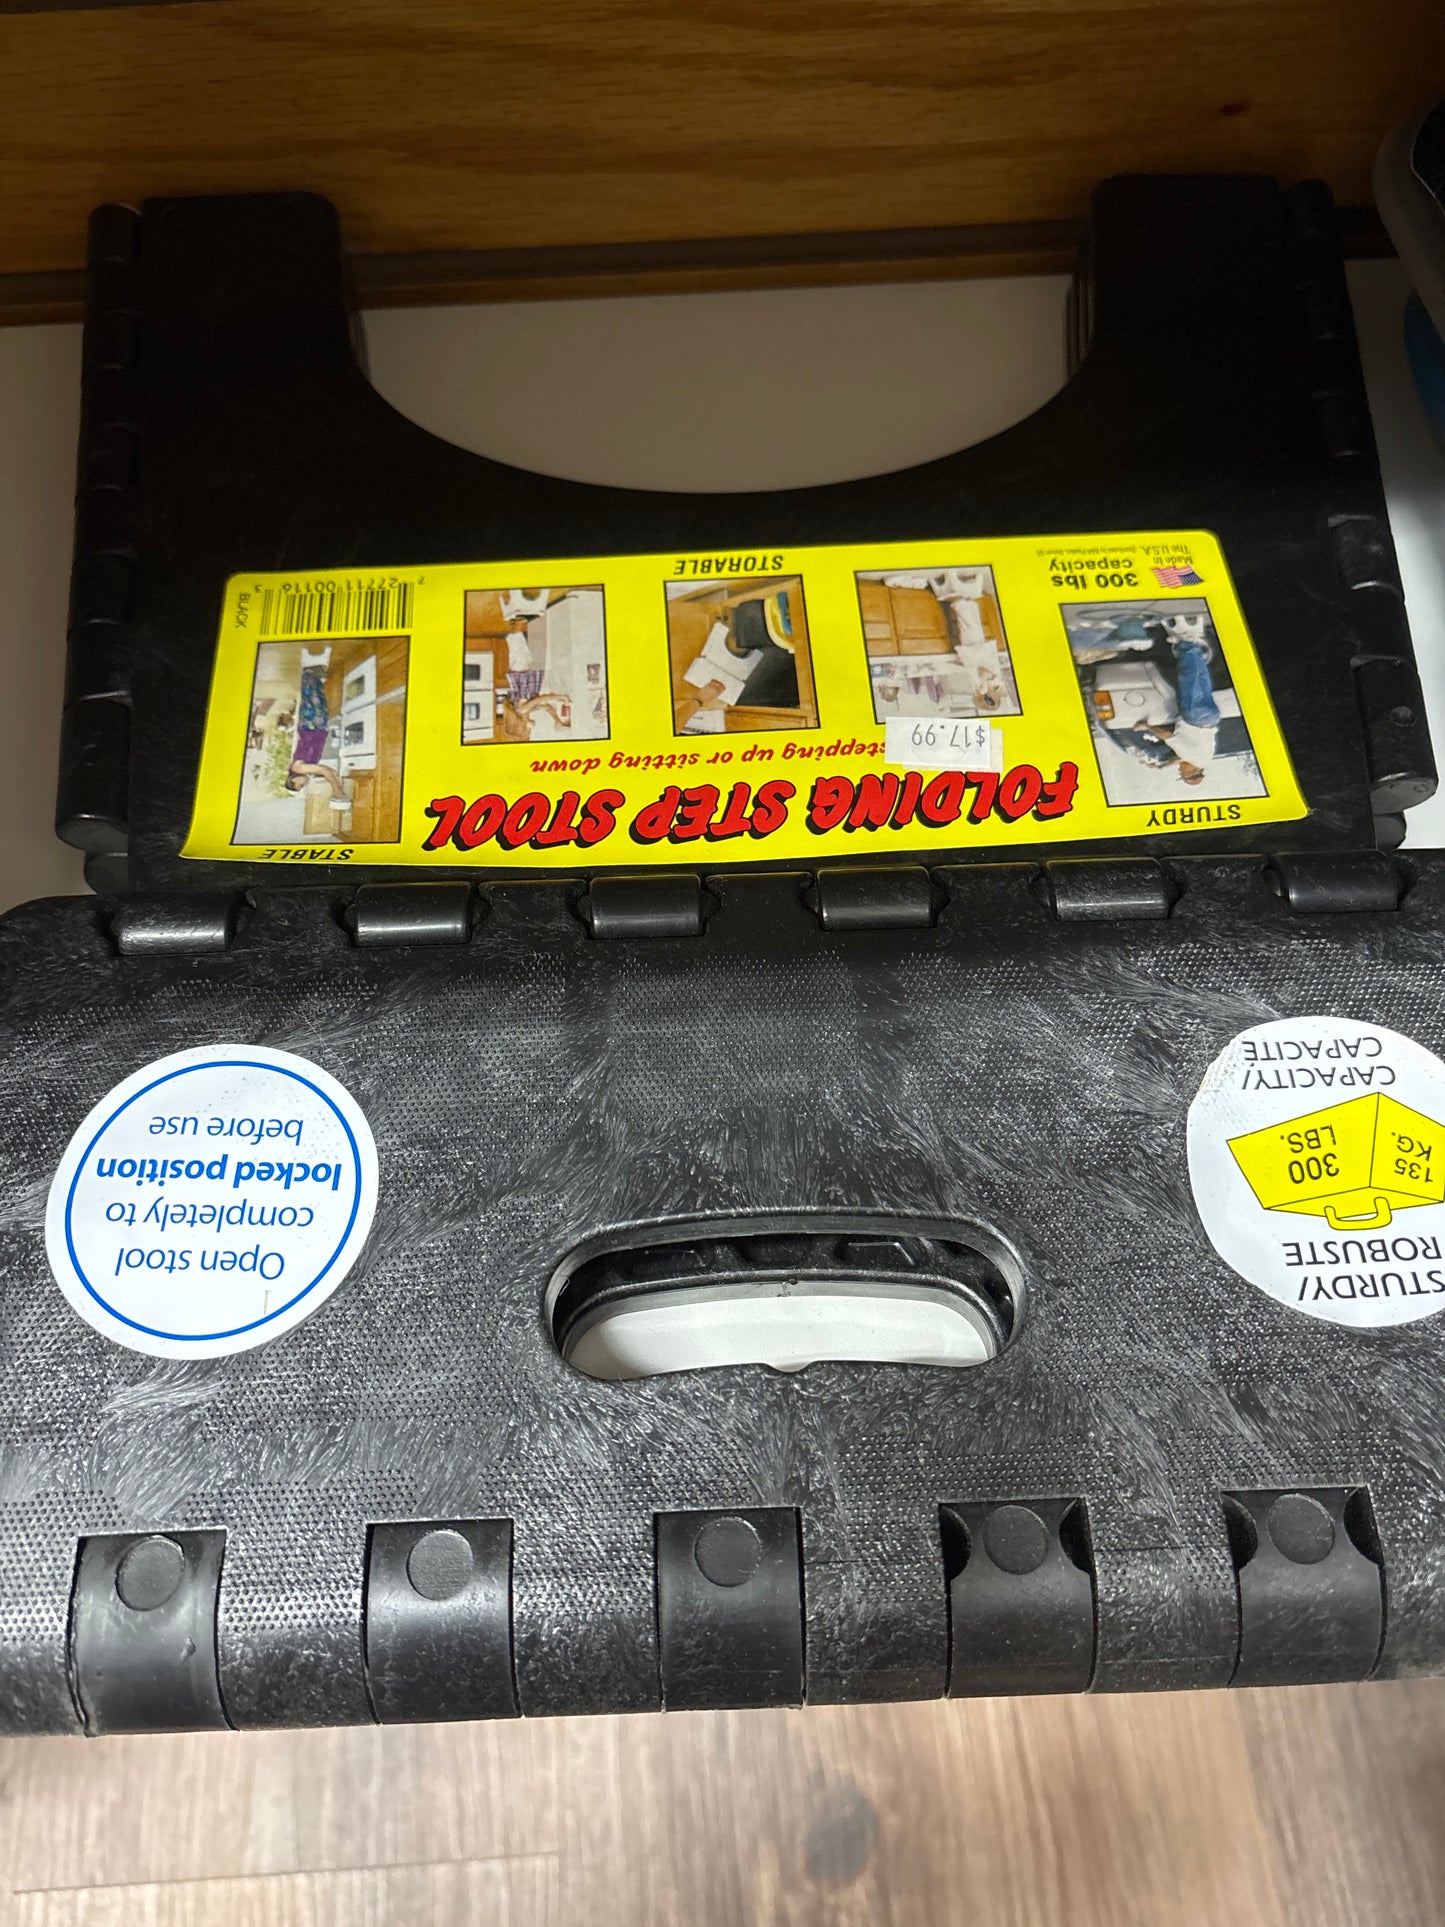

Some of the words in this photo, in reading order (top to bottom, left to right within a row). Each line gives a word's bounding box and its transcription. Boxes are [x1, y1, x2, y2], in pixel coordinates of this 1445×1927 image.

[1165, 555, 1193, 565] Made
[1171, 545, 1189, 554] The
[673, 555, 784, 575] STORABLE
[1048, 558, 1133, 574] capacity
[282, 581, 336, 594] 00116
[346, 577, 398, 591] 27711
[1050, 575, 1087, 590] lbs
[1094, 573, 1139, 588] 300
[235, 593, 251, 629] BLACK
[911, 723, 986, 748] $17.99
[530, 757, 601, 775] down
[609, 750, 700, 771] sitting
[710, 751, 734, 765] or
[742, 745, 774, 762] up
[805, 761, 1079, 836] FOLDING
[422, 788, 626, 852] STOOL
[628, 780, 797, 845] STEP
[1146, 805, 1241, 827] STURDY
[258, 849, 354, 861] STABLE
[1241, 1037, 1382, 1067] CAPACITÉ
[1241, 1065, 1396, 1090] CAPACITY/
[149, 1117, 199, 1136] use
[207, 1118, 304, 1146] before
[1280, 1124, 1337, 1154] LBS.
[1391, 1132, 1433, 1162] KG.
[96, 1154, 229, 1187] position
[233, 1162, 342, 1191] locked
[1288, 1153, 1340, 1185] 300
[1393, 1158, 1434, 1183] 135
[105, 1203, 137, 1227] to
[143, 1196, 314, 1233] completely
[115, 1248, 193, 1276] stool
[200, 1244, 285, 1280] Open
[1282, 1236, 1442, 1267] ROBUSTE
[1298, 1270, 1445, 1301] STURDY/
